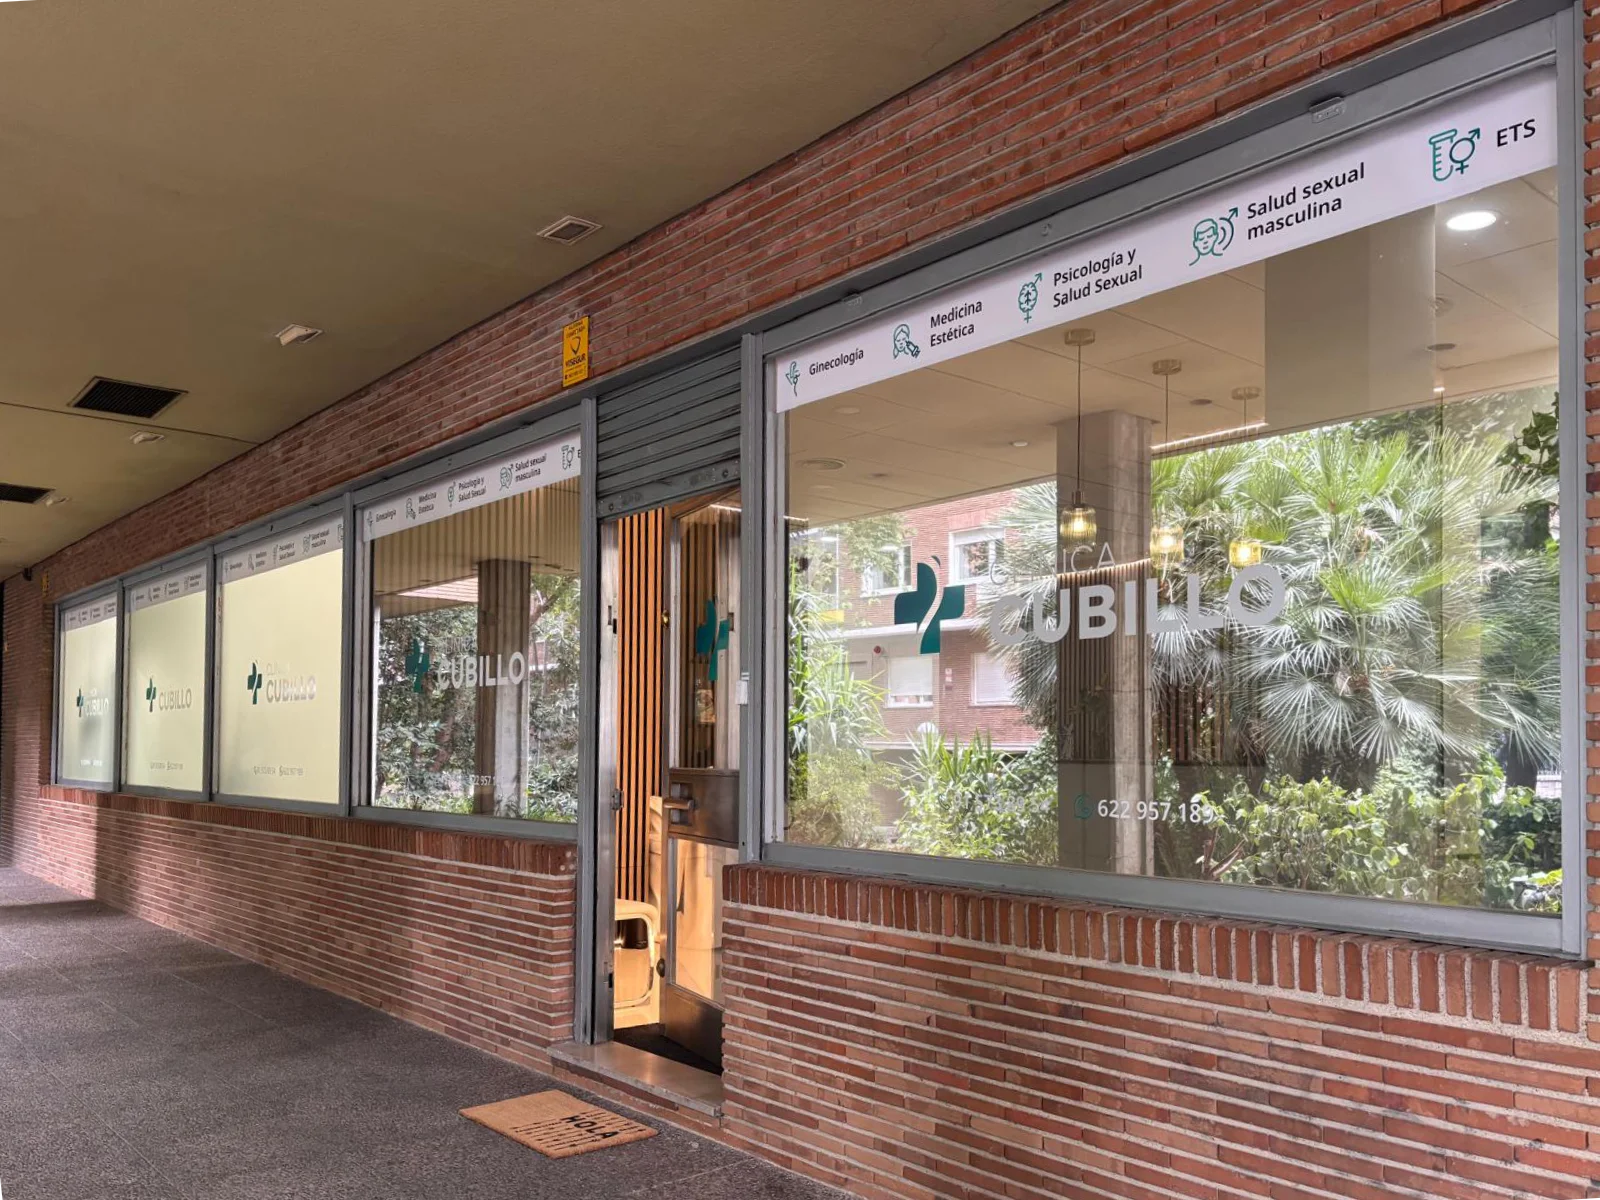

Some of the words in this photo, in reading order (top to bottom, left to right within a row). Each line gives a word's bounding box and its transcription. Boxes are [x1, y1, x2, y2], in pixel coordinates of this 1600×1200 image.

[1496, 119, 1536, 148] ETS
[1247, 188, 1297, 220] Salud
[1302, 162, 1366, 200] sexual
[1247, 197, 1343, 241] masculina
[1053, 251, 1124, 287] Psicología
[1127, 248, 1137, 266] y
[1053, 282, 1091, 308] Salud
[1094, 264, 1143, 294] Sexual
[929, 299, 984, 329] Medicina
[929, 321, 976, 347] Estética
[808, 348, 865, 377] Ginecología
[990, 564, 1288, 646] CUBILLO
[437, 651, 526, 690] CUBILLO
[159, 688, 193, 711] CUBILLO
[1097, 799, 1132, 819] 622
[1136, 800, 1171, 821] 957
[1178, 803, 1214, 824] 189
[560, 1114, 620, 1140] HOLA
